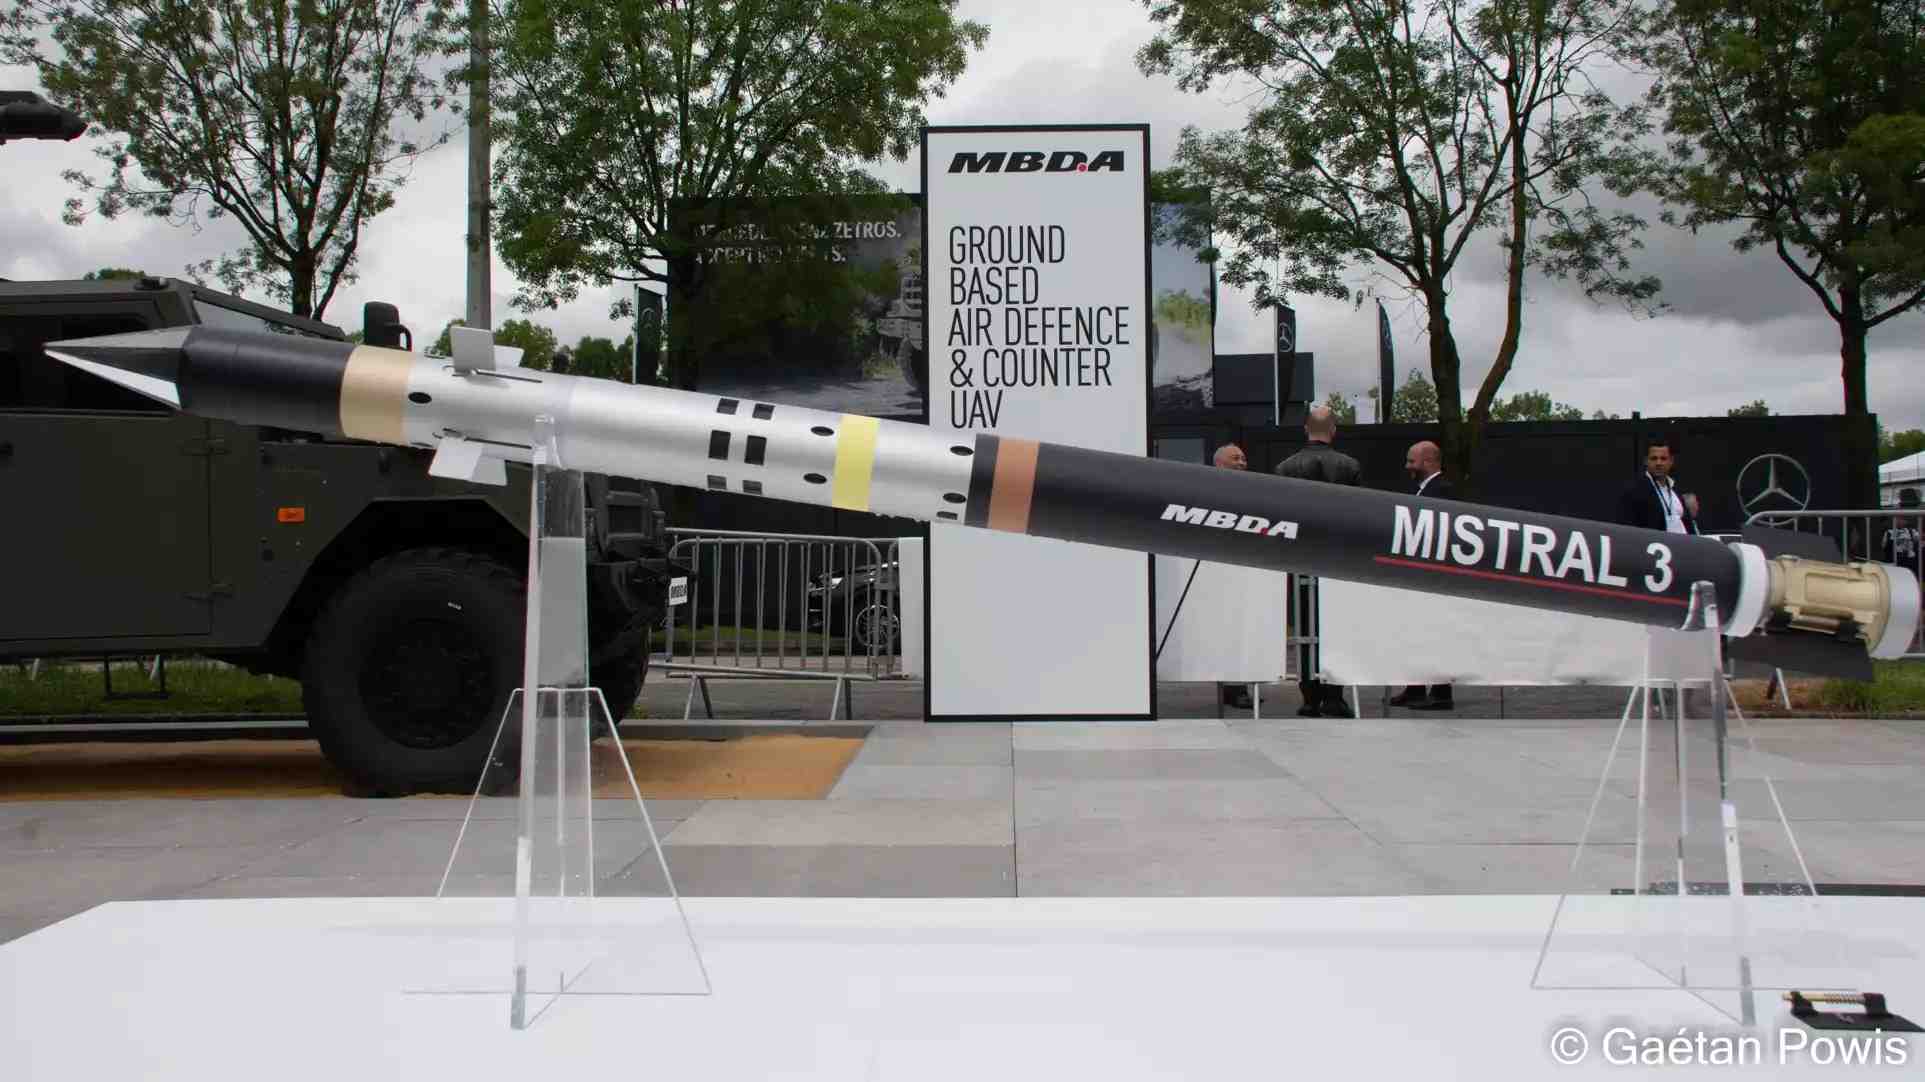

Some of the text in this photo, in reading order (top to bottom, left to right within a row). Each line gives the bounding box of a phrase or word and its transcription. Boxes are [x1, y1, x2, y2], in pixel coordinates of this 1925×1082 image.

[948, 151, 1124, 173] MBDA
[949, 225, 1065, 264] GROUND
[950, 267, 1039, 305] BASED
[948, 306, 1130, 346] AIR DEFENCE
[950, 348, 1112, 388] & COUNTER
[951, 390, 1003, 429] UAV
[1160, 504, 1299, 539] MBDA
[1391, 505, 1672, 592] MISTRAL 3
